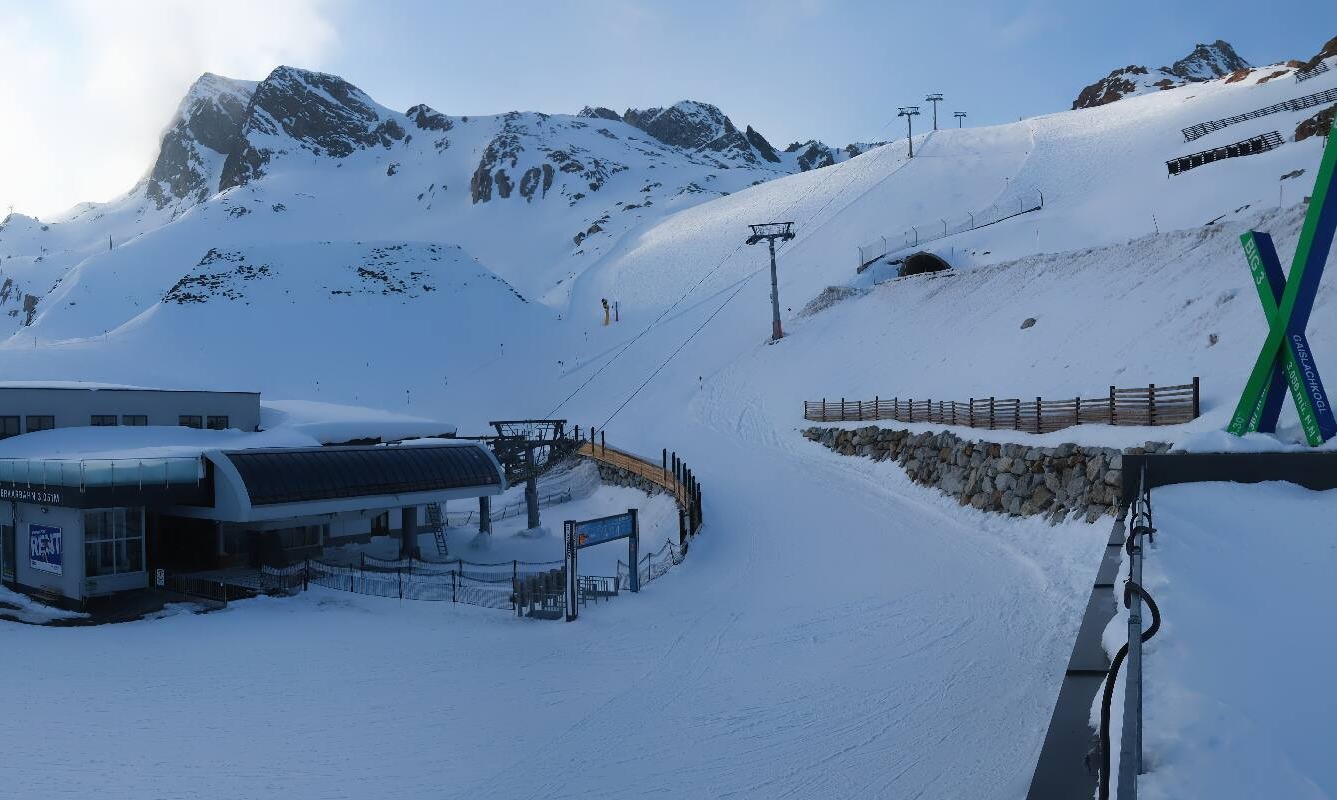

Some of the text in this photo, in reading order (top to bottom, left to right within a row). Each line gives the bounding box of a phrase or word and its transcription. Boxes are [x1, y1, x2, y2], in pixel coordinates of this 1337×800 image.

[1245, 238, 1265, 285] BIG 3
[1293, 334, 1327, 415] GAISLACHKOGL
